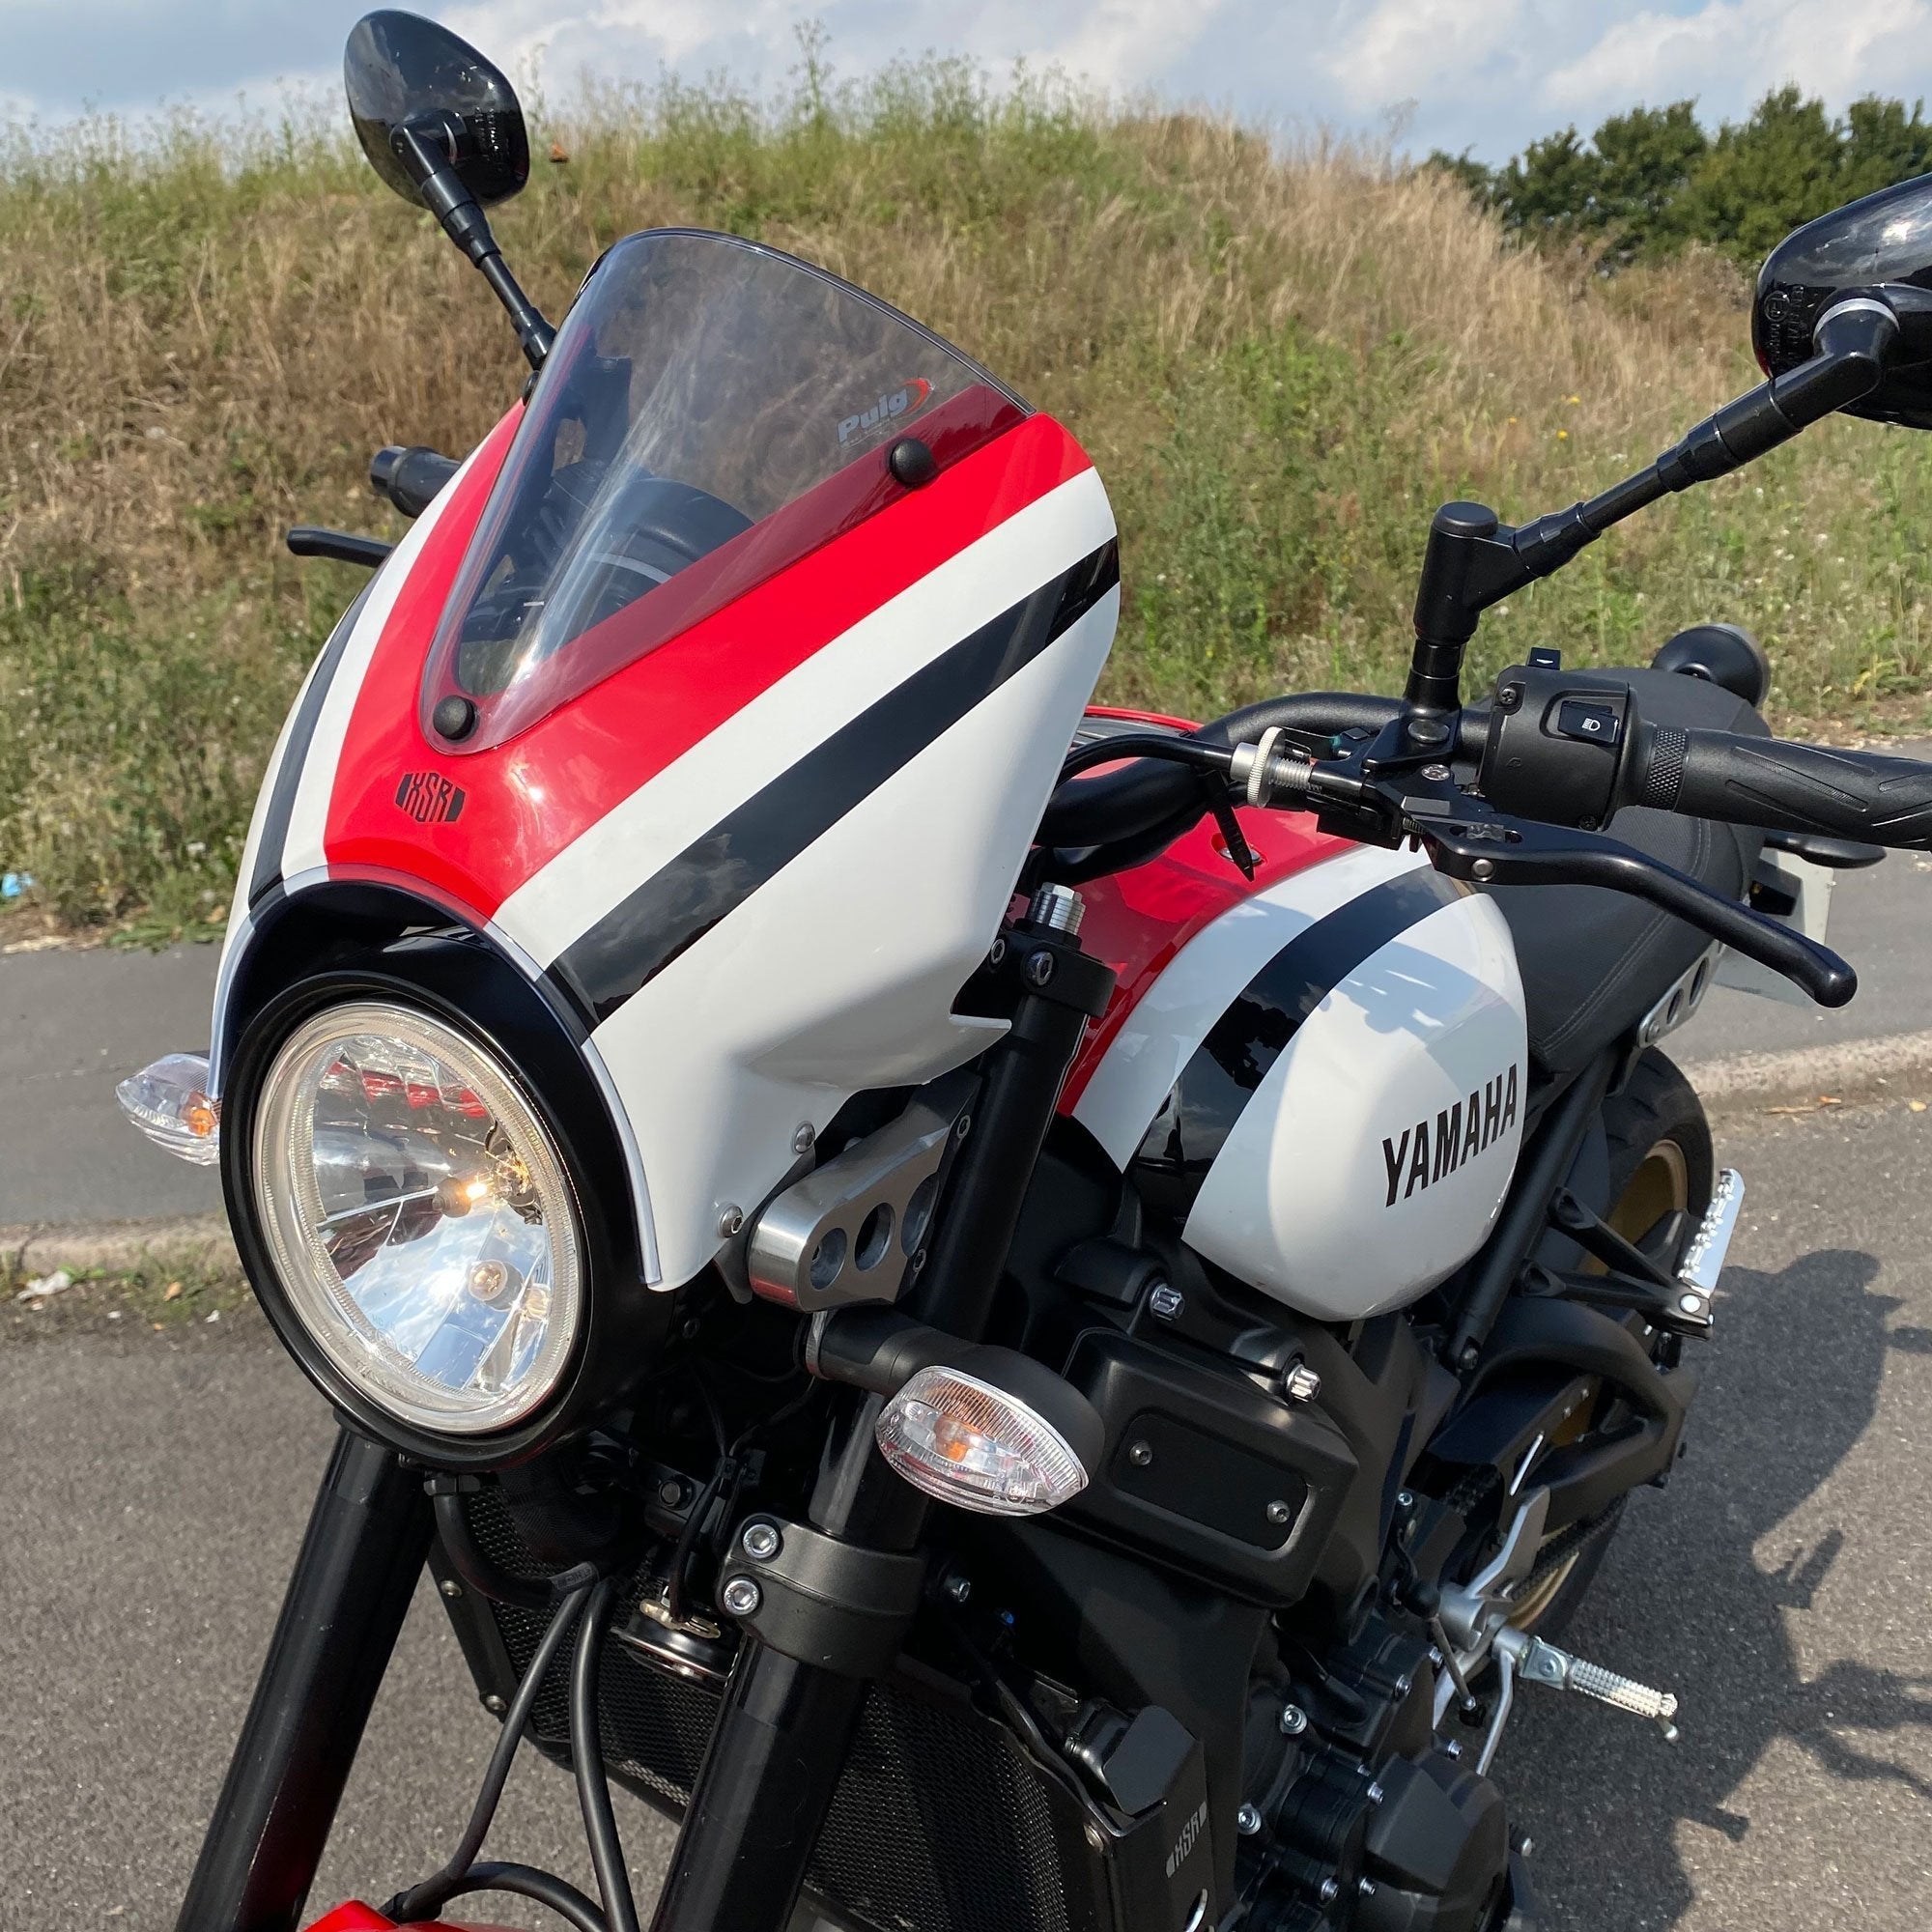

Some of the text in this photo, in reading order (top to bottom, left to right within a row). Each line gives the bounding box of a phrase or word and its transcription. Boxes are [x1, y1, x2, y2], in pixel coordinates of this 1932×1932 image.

[838, 388, 908, 442] Puig
[403, 772, 454, 823] XSR
[1381, 1063, 1518, 1208] YAMAHA
[1174, 1810, 1201, 1870] XSR
